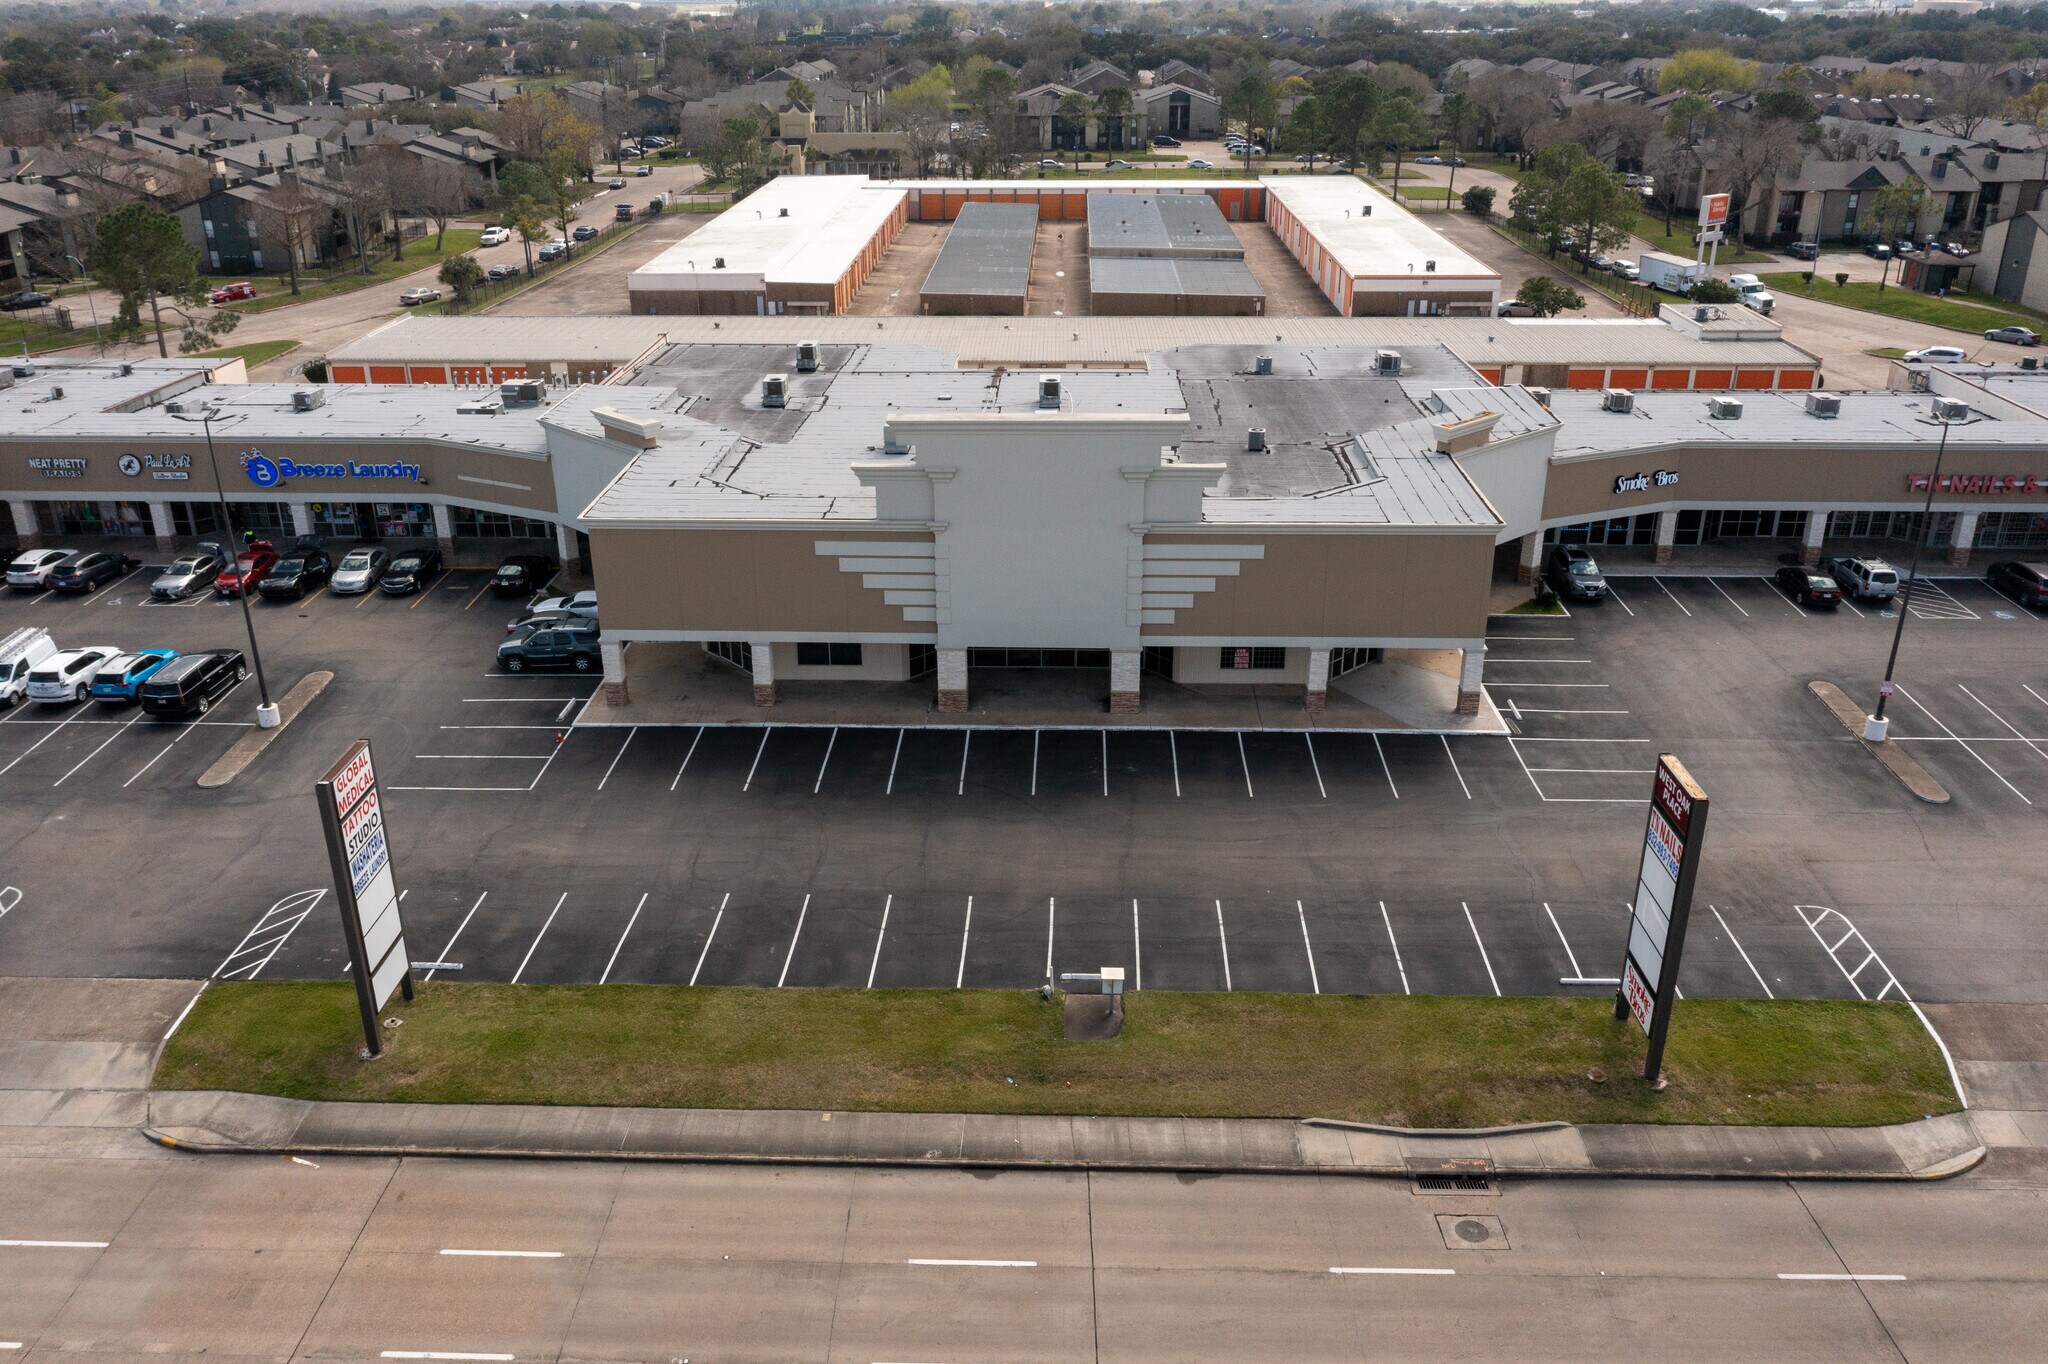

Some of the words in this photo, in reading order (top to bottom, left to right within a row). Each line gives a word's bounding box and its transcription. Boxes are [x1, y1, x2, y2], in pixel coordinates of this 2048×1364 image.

[28, 458, 51, 469] NEAT
[53, 458, 87, 469] PRETTY
[144, 454, 163, 468] Paul
[279, 457, 346, 478] Breeze
[348, 459, 420, 481] Laundry
[1615, 473, 1650, 494] Smoke
[1655, 470, 1679, 487] Bros
[1949, 474, 2017, 495] NAILS
[2023, 474, 2038, 494] &
[337, 752, 368, 793] GLOBAL
[338, 769, 374, 816] MEDICAL
[1659, 765, 1677, 793] WEST
[1676, 789, 1691, 815] OAK
[342, 792, 377, 838] TATTOO
[1662, 788, 1683, 820] PLACE
[348, 812, 378, 855] STUDIO
[351, 829, 384, 880] WASHATERIA
[1659, 821, 1682, 865] NAILS
[354, 870, 370, 896] BREEZE
[369, 848, 387, 877] LAUNDRY
[1627, 965, 1650, 1015] Smoke
[1628, 985, 1645, 1025] Bros
